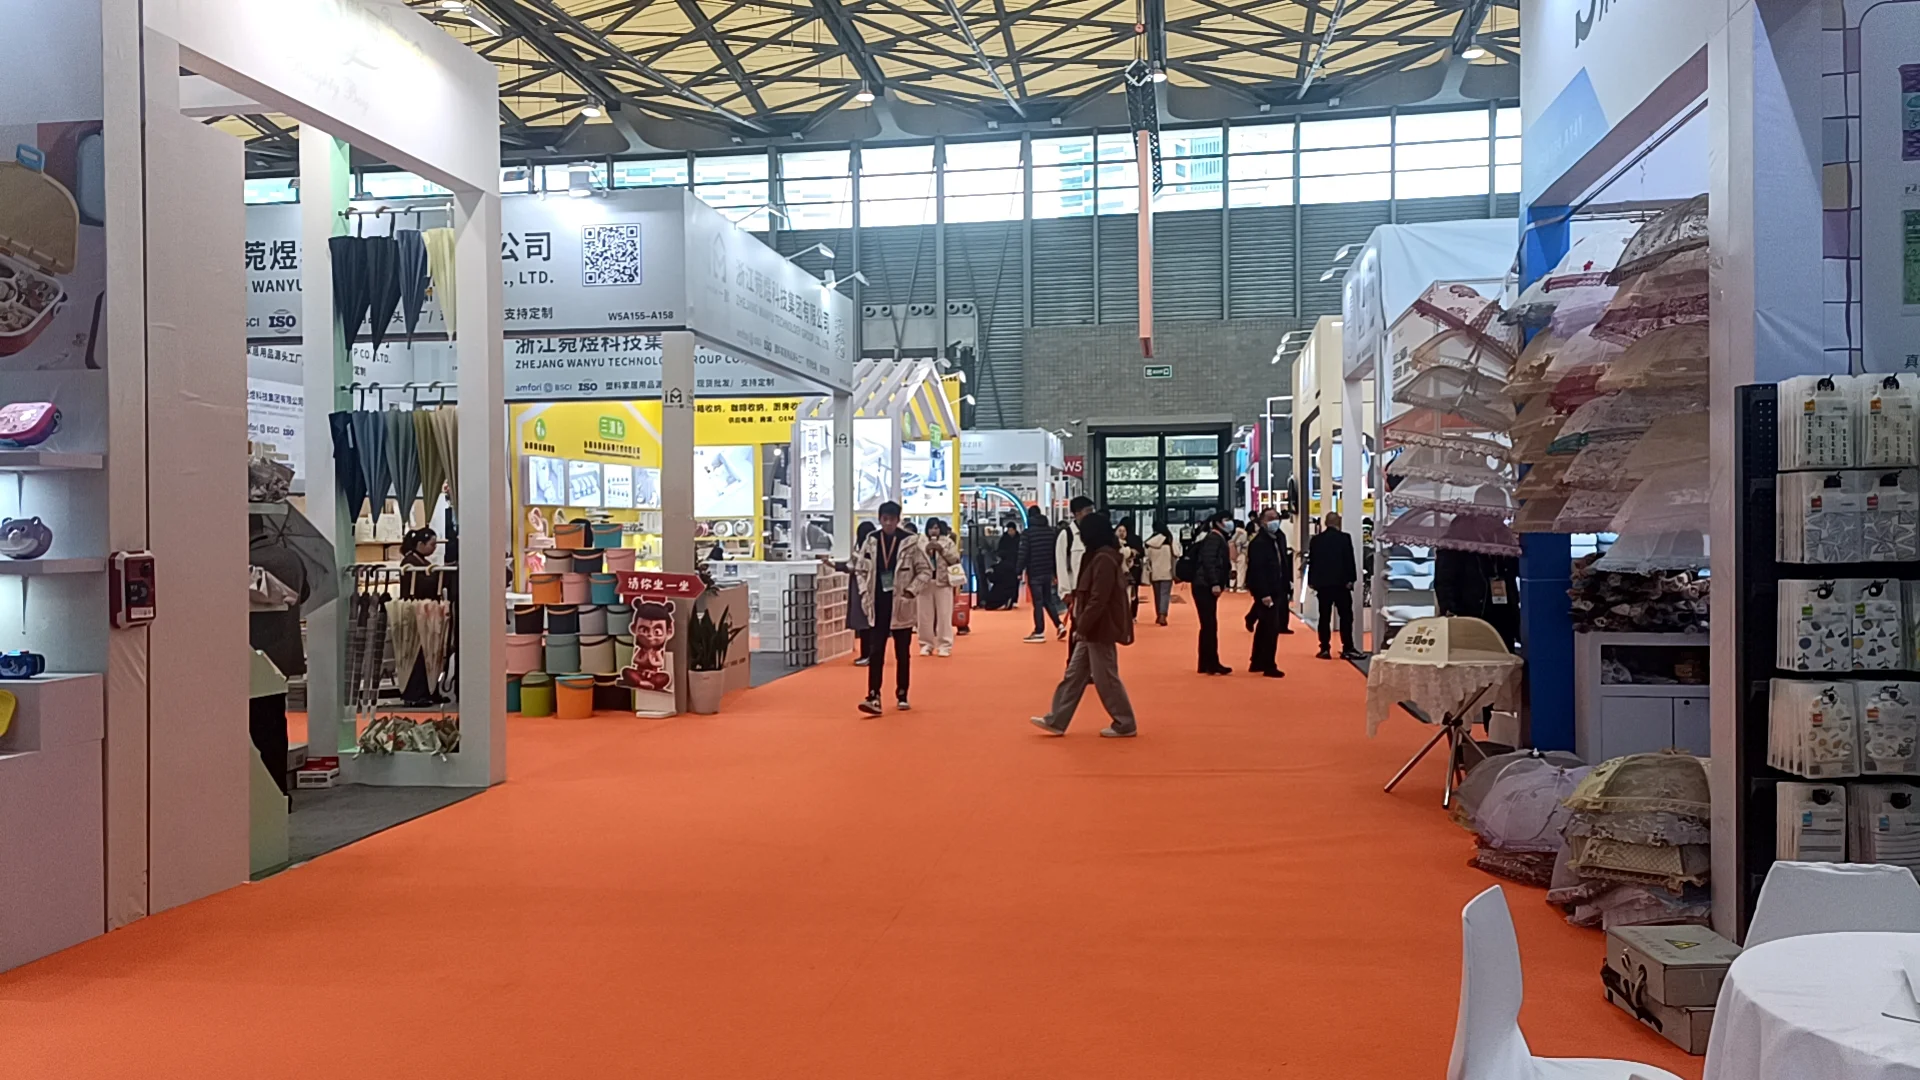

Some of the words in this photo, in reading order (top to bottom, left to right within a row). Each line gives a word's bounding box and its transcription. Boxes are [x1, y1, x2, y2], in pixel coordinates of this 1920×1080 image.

[501, 231, 552, 262] 公司
[519, 270, 554, 284] LTD.
[504, 306, 553, 321] 支持定制
[608, 310, 674, 322] W5A155-A158
[268, 314, 297, 329] ISO
[515, 358, 564, 369] ZHEJANG
[567, 357, 605, 368] WANYU
[578, 382, 598, 392] ISO
[627, 576, 690, 592] 请你坐一坐
